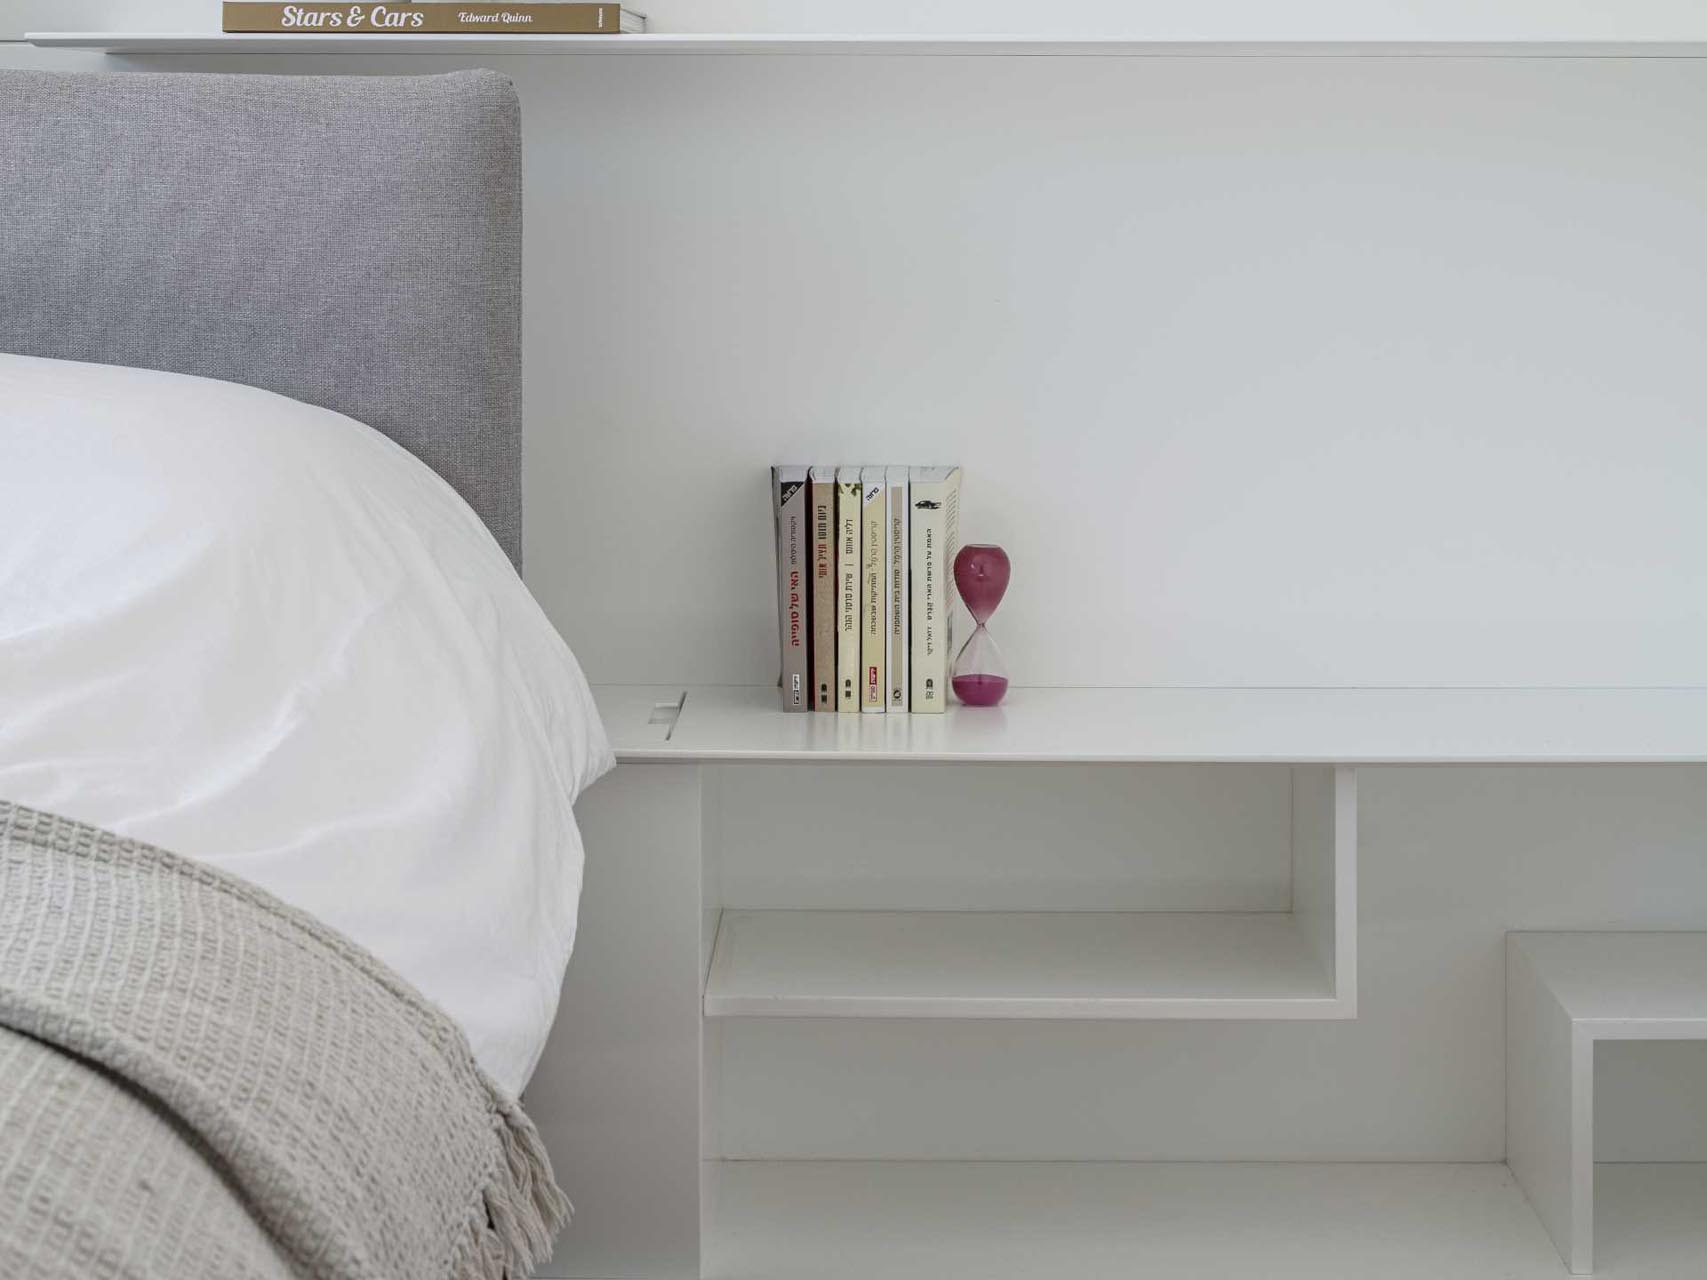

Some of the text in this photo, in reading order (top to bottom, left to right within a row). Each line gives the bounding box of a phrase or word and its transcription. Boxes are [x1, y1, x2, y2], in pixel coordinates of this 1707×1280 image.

[281, 5, 424, 28] Stars & Cars
[457, 11, 533, 24] Edward Quinn
[845, 519, 853, 535] דליה
[845, 573, 853, 591] שירת
[789, 571, 800, 647] האי של סופייה
[845, 614, 853, 632] הנהר
